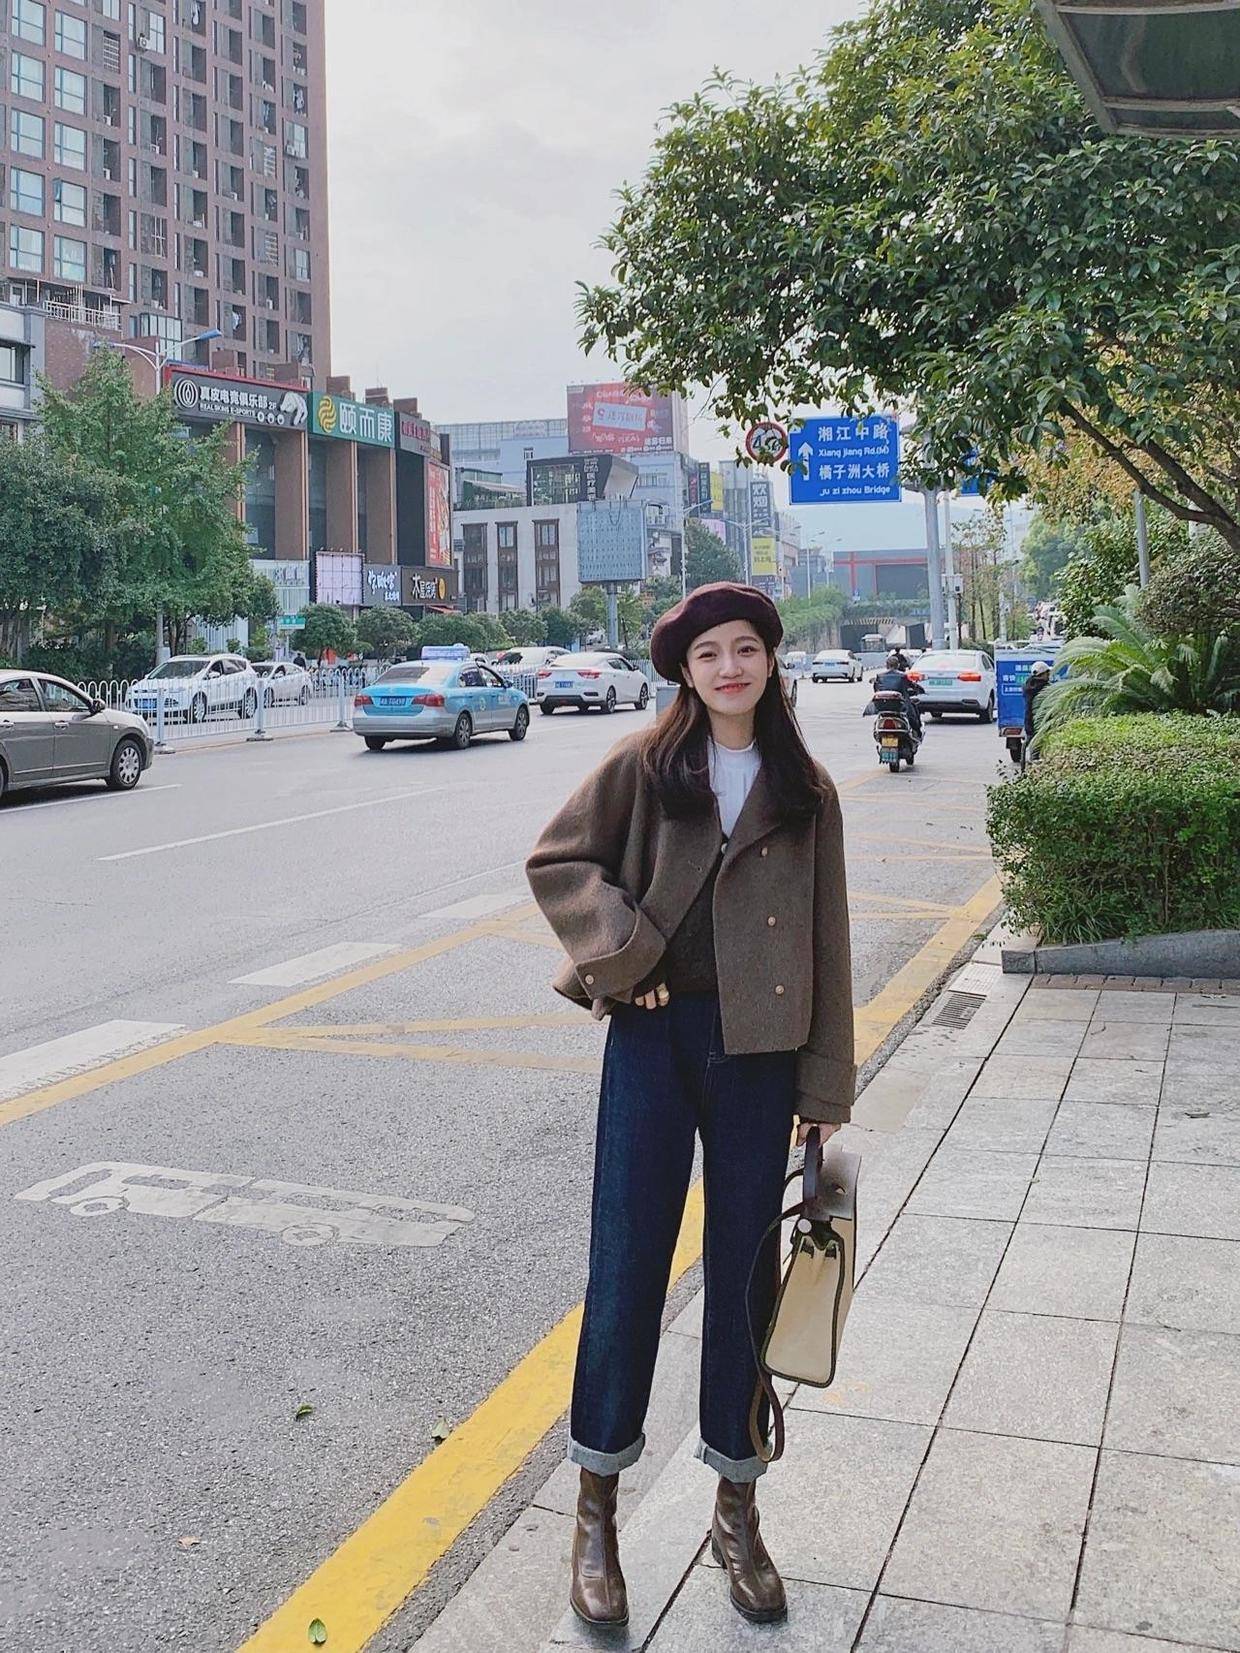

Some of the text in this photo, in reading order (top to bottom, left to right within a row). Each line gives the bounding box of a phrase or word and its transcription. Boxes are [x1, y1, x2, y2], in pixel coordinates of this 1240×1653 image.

[200, 386, 268, 409] 真皮电竞俱乐部
[340, 402, 393, 442] 颐而康
[818, 423, 889, 442] 湘江中路
[818, 448, 841, 458] Xiang
[841, 486, 862, 495] zhou
[863, 485, 891, 496] Bridge
